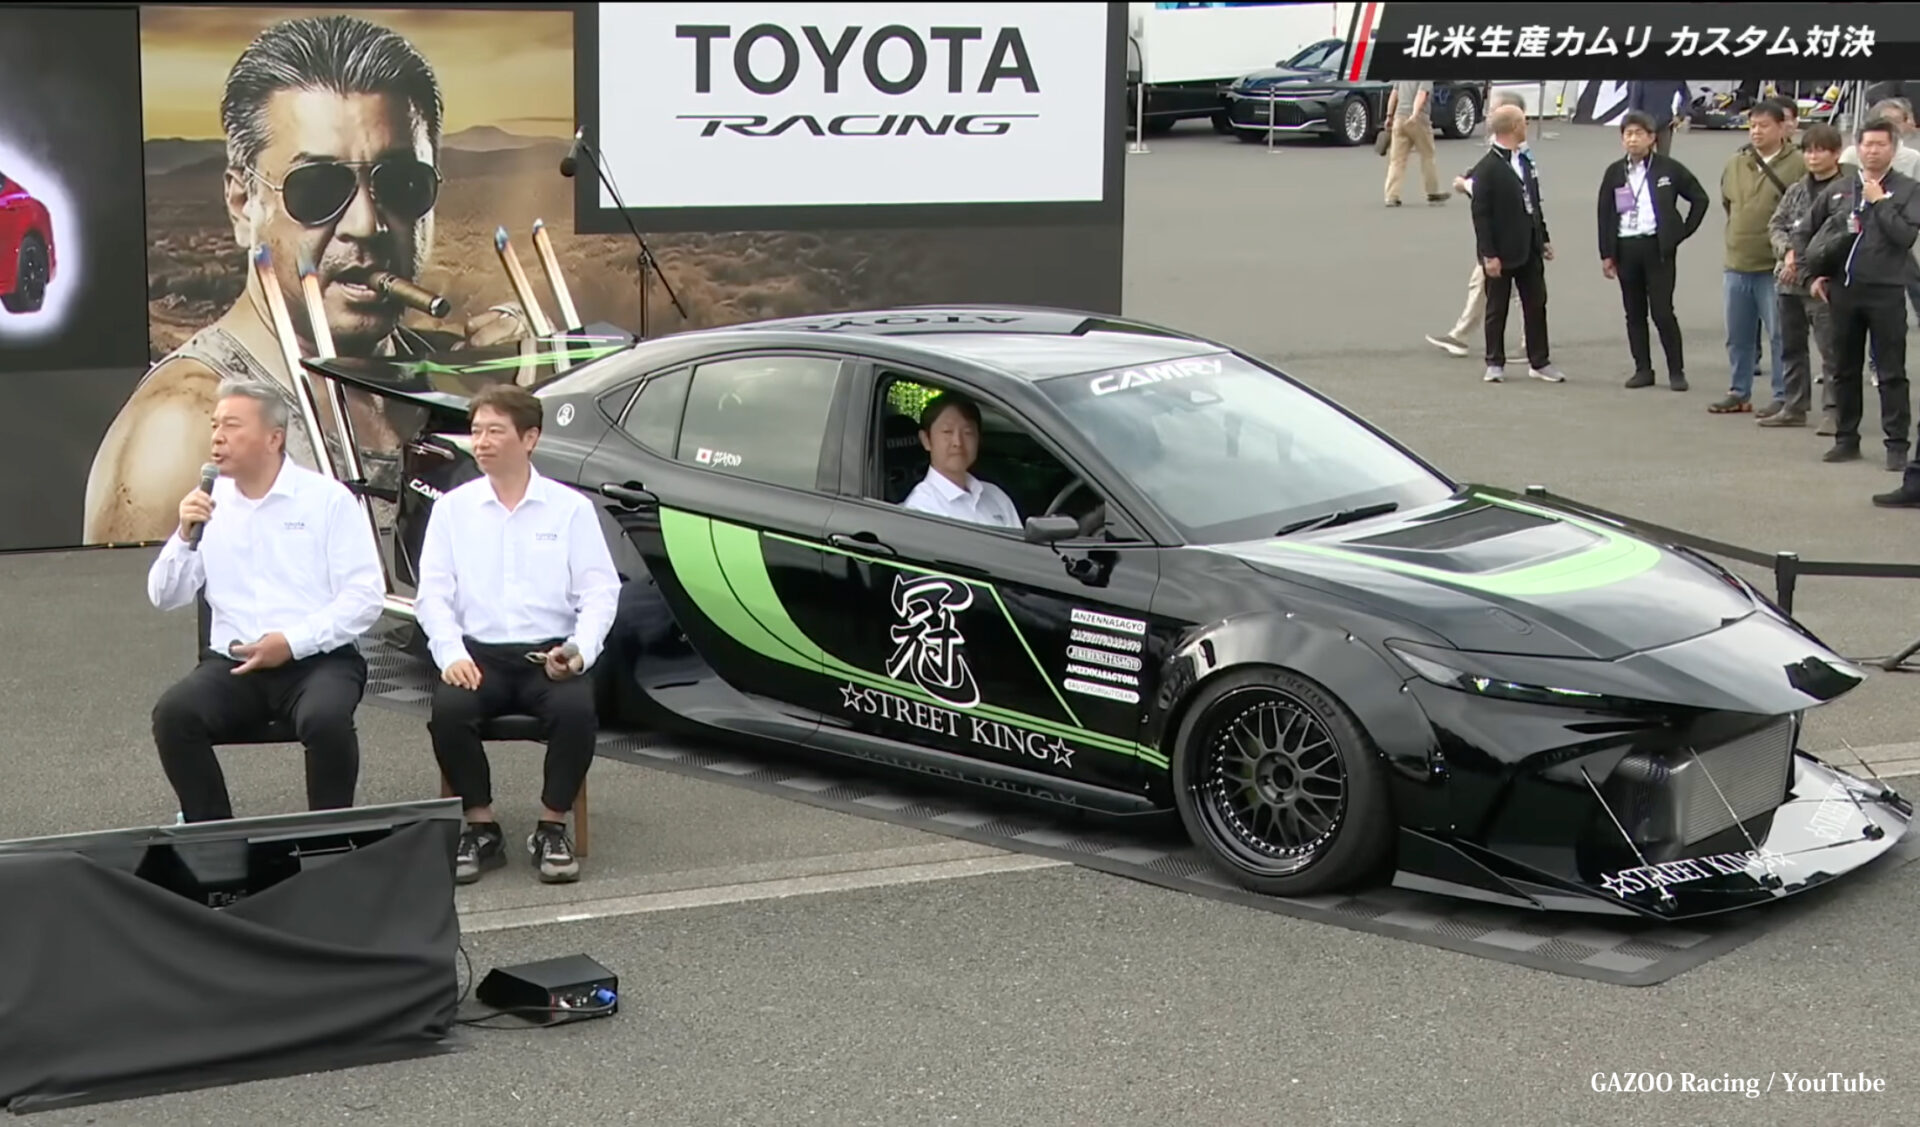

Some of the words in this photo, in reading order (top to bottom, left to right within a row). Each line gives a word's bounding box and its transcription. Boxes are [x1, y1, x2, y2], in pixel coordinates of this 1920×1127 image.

[676, 23, 1040, 95] TOYOTA
[676, 114, 1040, 137] RACING
[1090, 359, 1222, 396] CAMRY
[409, 478, 444, 500] CAM
[1073, 611, 1144, 632] ANZENNASAGYO
[886, 574, 981, 708] 冠
[862, 688, 961, 737] STREET
[970, 716, 1049, 760] KING
[1618, 858, 1713, 892] STREET
